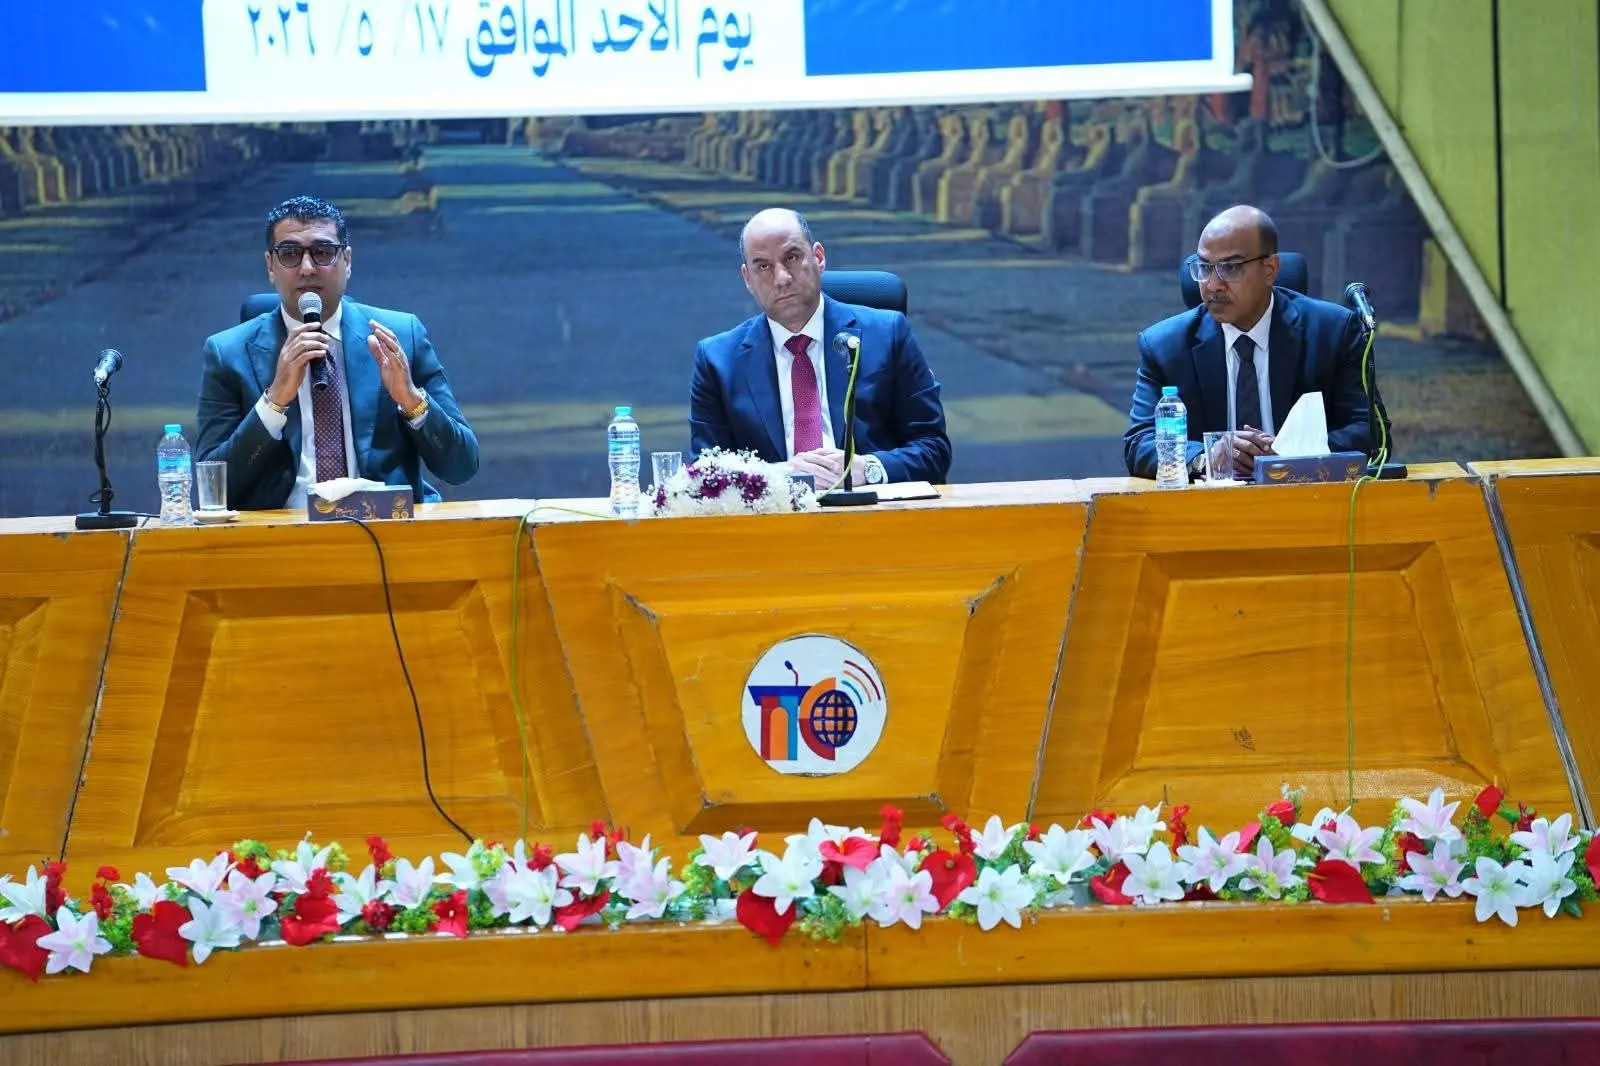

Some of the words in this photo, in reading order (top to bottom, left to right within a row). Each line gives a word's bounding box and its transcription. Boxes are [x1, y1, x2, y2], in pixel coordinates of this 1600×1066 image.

[246, 2, 316, 57] ٢٠٢٦
[466, 0, 577, 79] الموافق
[592, 0, 681, 55] الاحد
[696, 6, 755, 79] يوم
